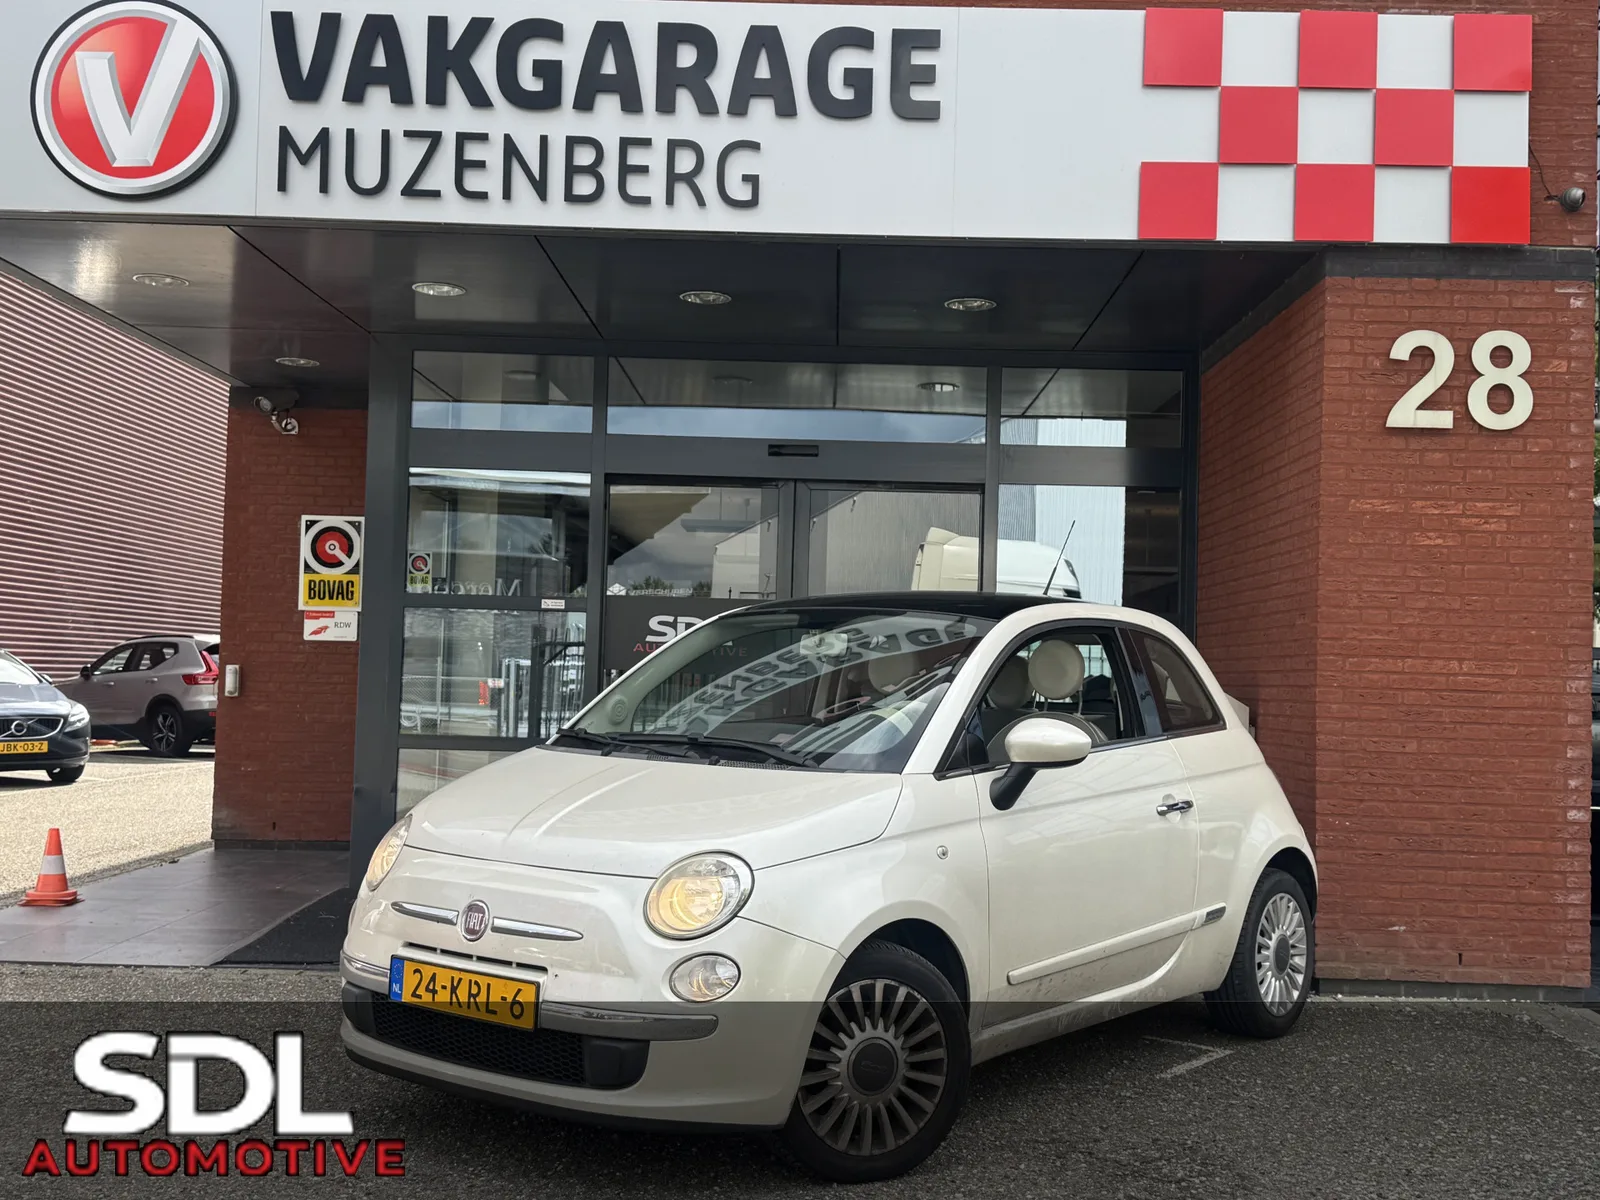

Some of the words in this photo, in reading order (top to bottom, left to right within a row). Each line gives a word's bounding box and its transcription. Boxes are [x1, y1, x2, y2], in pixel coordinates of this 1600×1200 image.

[270, 10, 942, 120] VAKGARAGE
[276, 125, 762, 208] MUZENBERG
[1385, 329, 1534, 431] 28
[308, 579, 355, 602] BOVAG
[334, 621, 352, 629] RDW
[0, 742, 44, 752] JBK-03-Z
[466, 911, 483, 930] FIAT
[392, 982, 402, 994] NL
[411, 968, 525, 1020] 24-KRL-6
